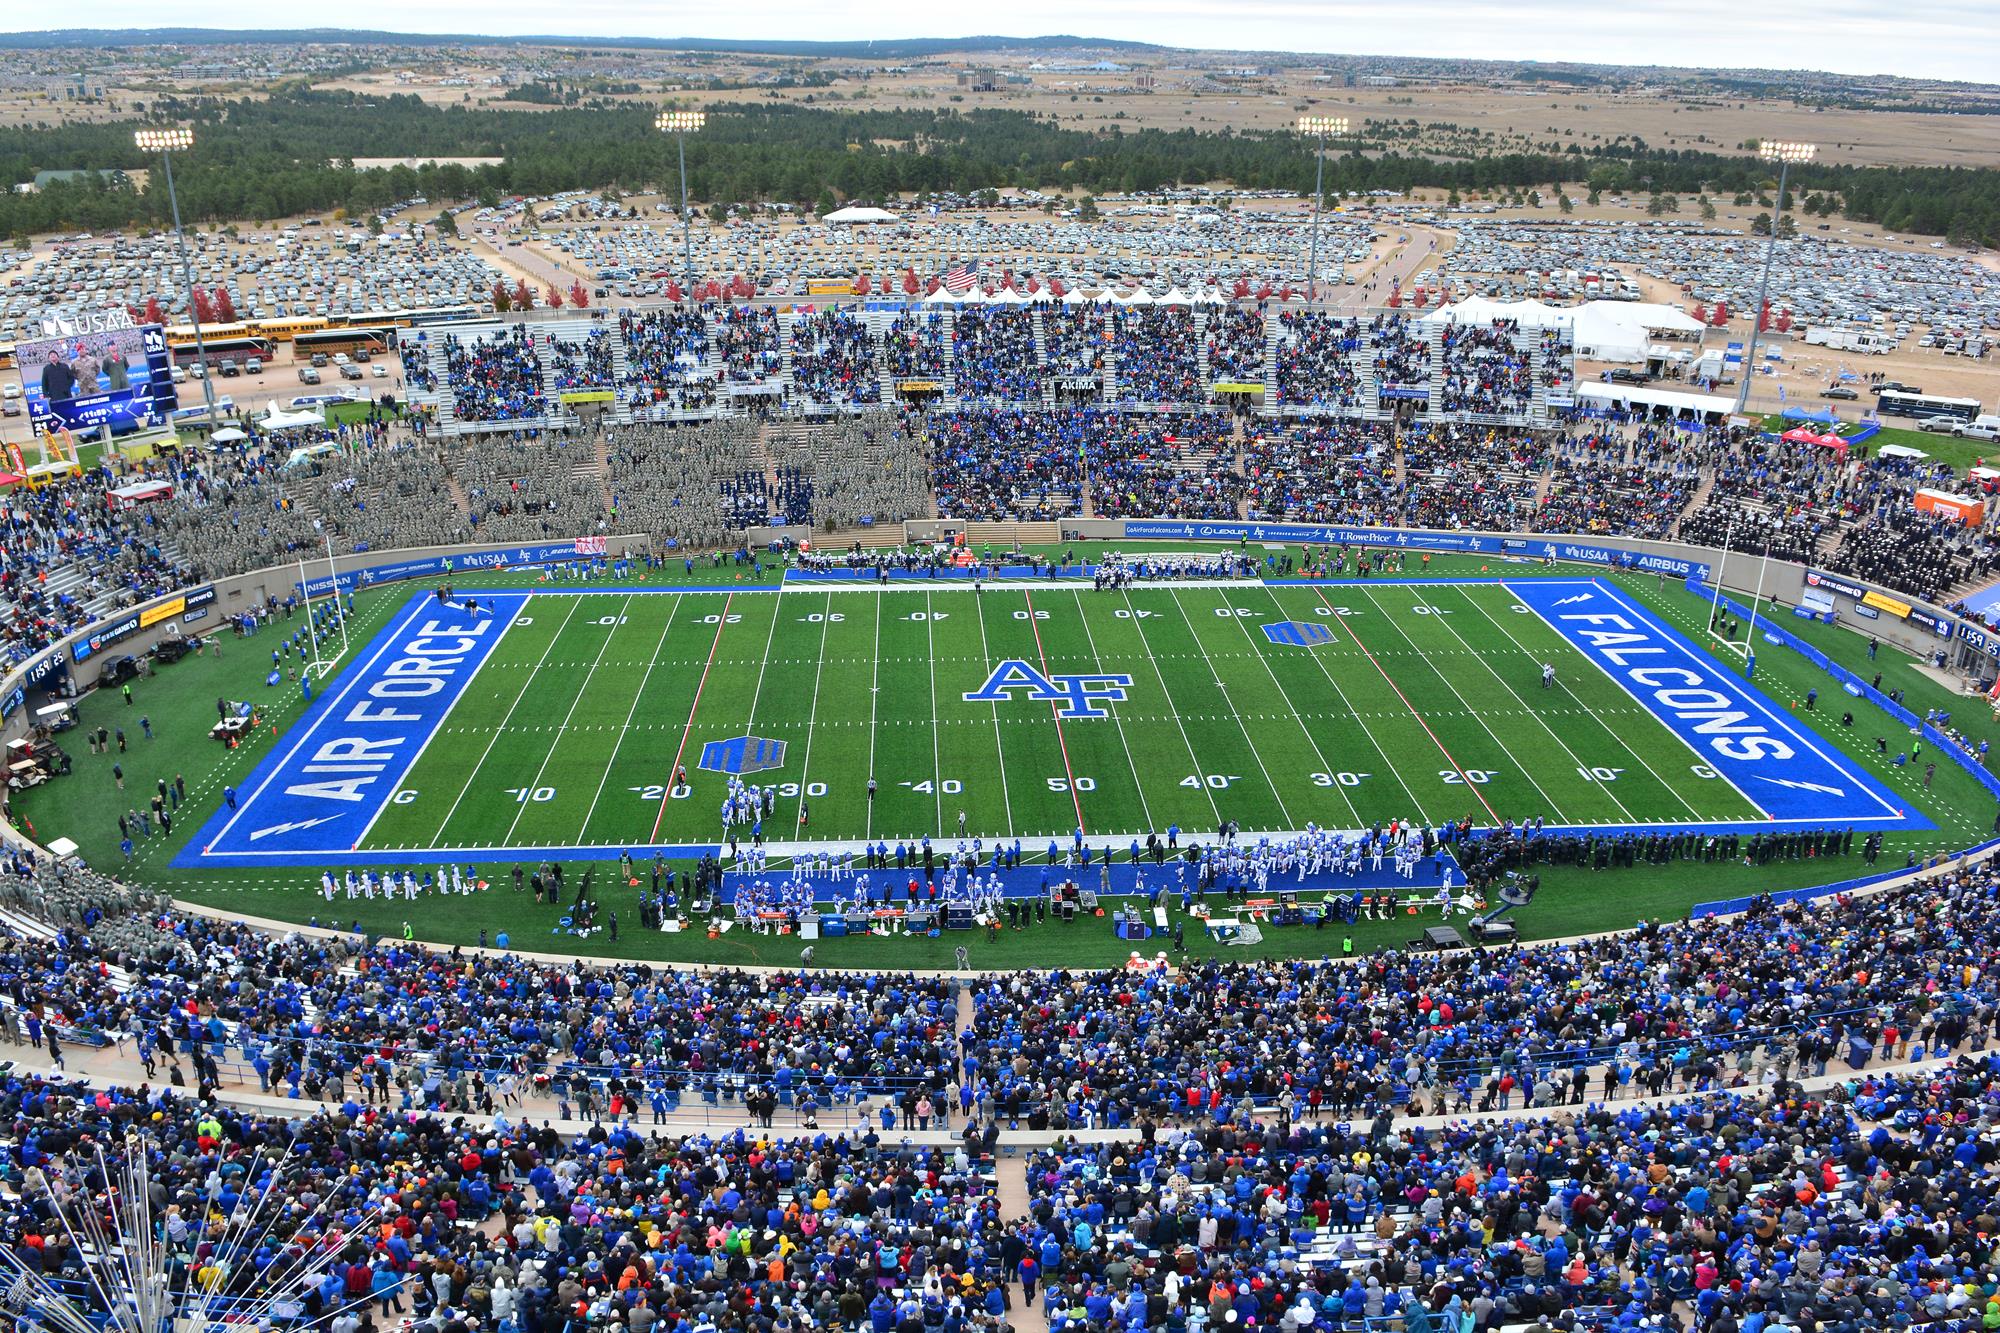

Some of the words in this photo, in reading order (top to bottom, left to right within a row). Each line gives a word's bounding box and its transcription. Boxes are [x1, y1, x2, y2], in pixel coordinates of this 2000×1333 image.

[75, 310, 134, 335] USAA
[146, 345, 164, 353] USAA
[1060, 381, 1096, 390] AKIMA
[84, 409, 107, 419] 11:59
[34, 421, 48, 431] 21
[1126, 525, 1182, 534] GoAirForceFalcons.com
[1183, 524, 1195, 537] AF
[1253, 526, 1265, 539] AF
[1324, 529, 1336, 542] AF
[1396, 532, 1408, 546] AF
[1469, 537, 1482, 550] AF
[518, 549, 531, 562] AF
[550, 547, 577, 555] BOEIN
[576, 543, 608, 553] NAVY
[1580, 549, 1609, 562] USAA
[478, 553, 508, 566] USAA
[1638, 556, 1690, 574] AIRBUS
[362, 569, 375, 583] AF
[1696, 565, 1710, 580] AF
[307, 576, 351, 593] NISSAN
[187, 594, 208, 605] SAFEWAY
[114, 623, 131, 636] GAME
[1960, 627, 1984, 647] 11:59
[1987, 642, 1998, 656] 25
[30, 659, 51, 682] 11:59
[53, 651, 64, 666] 25
[344, 619, 493, 722] FORCE
[962, 659, 1134, 719] AF
[1558, 614, 1796, 761] FALCONS
[284, 737, 406, 803] AIR
[1438, 769, 1488, 784] 20
[1575, 767, 1617, 782] 10
[1690, 765, 1718, 779] G
[913, 779, 963, 794] 40
[1046, 777, 1097, 792] 50
[1179, 774, 1231, 789] 40
[1310, 772, 1359, 787] 30
[516, 787, 556, 802] 10
[641, 785, 692, 800] 20
[778, 782, 828, 797] 30
[393, 790, 418, 805] G
